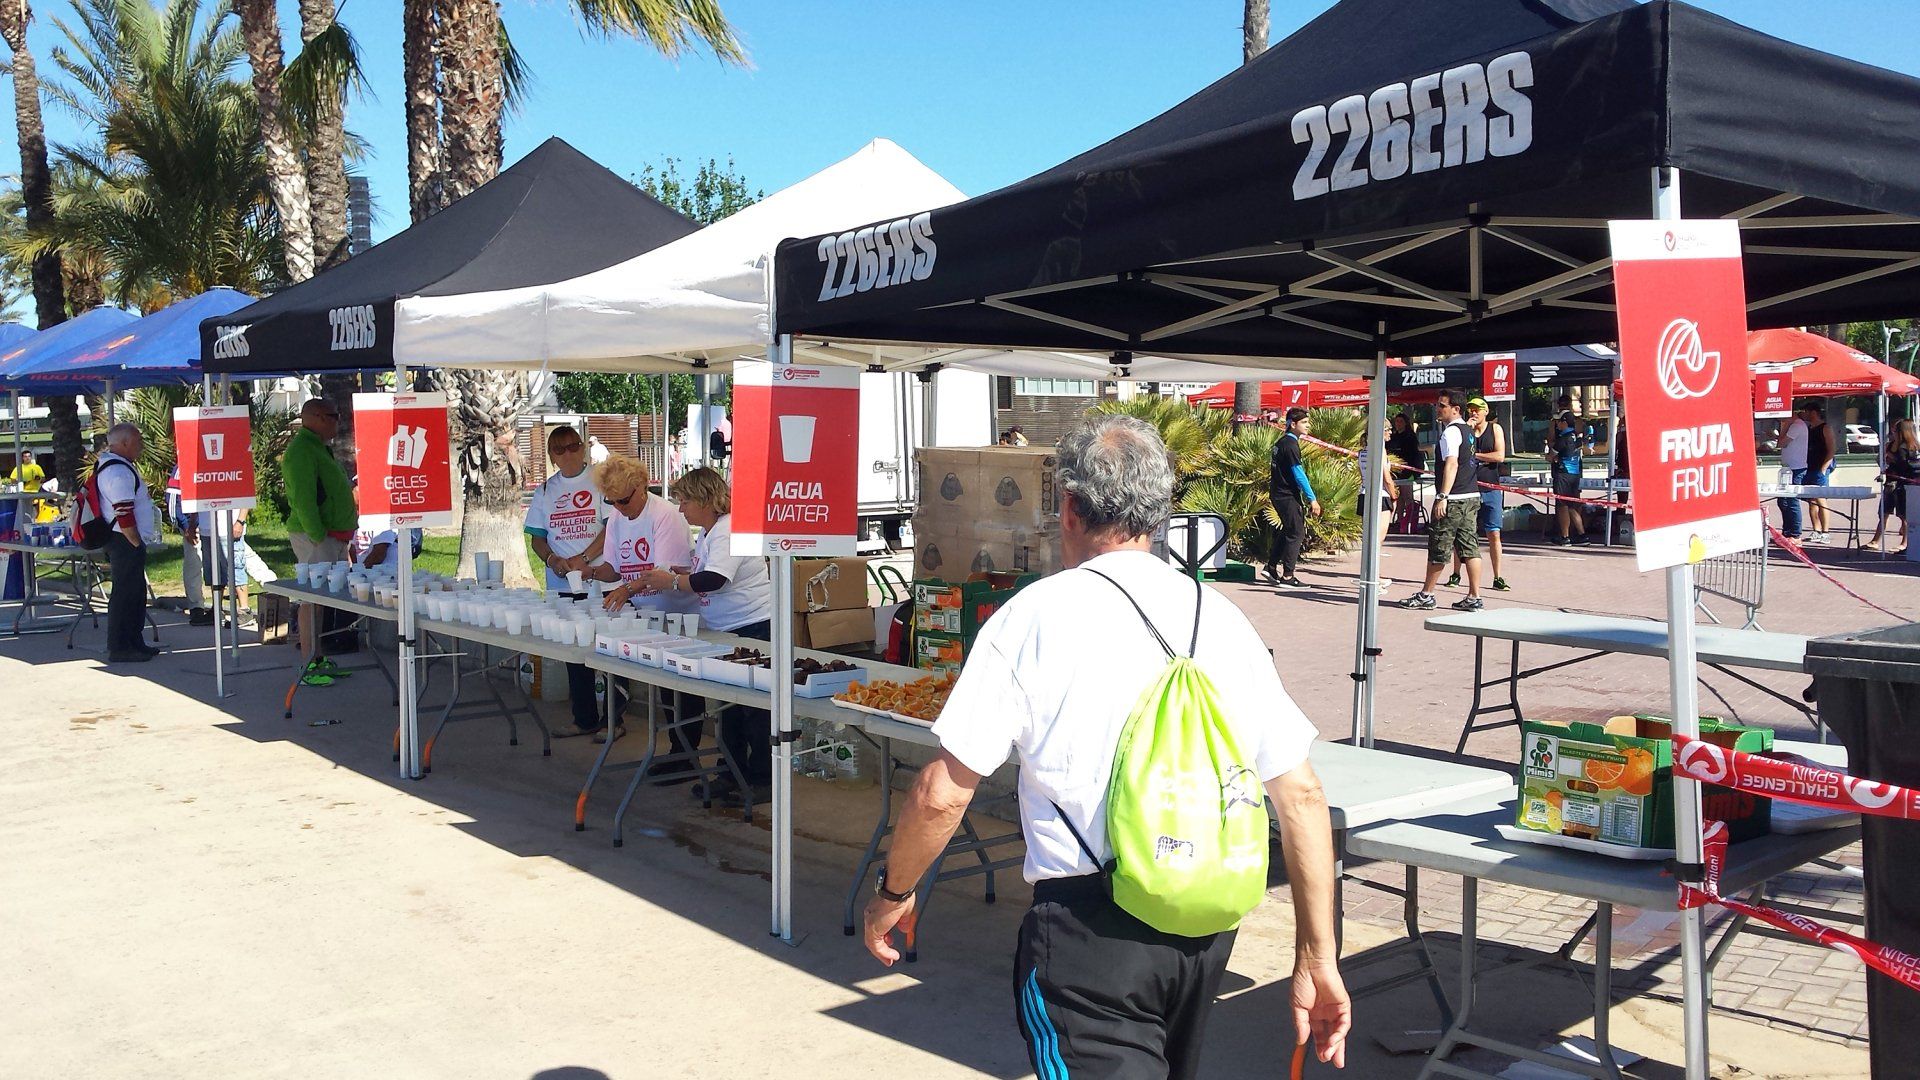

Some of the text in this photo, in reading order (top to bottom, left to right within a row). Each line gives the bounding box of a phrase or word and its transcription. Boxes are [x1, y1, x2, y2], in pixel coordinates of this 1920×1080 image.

[1291, 51, 1533, 201] 226ERS
[817, 211, 938, 302] 226ERS
[329, 304, 376, 351] 226ERS
[1402, 368, 1446, 387] 226ERS
[9, 419, 38, 431] PZERIA
[1660, 423, 1735, 463] FRUTA
[193, 470, 243, 484] ISOTONIC
[384, 474, 429, 490] GELES
[1672, 461, 1732, 502] FRUIT
[390, 490, 426, 505] GELS
[771, 481, 823, 500] AGUA
[550, 516, 596, 529] CHALLENGE
[767, 504, 829, 523] WATER
[561, 525, 588, 535] SALOU
[1792, 765, 1839, 785] SPAIN
[1742, 774, 1839, 799] CHALLENGE
